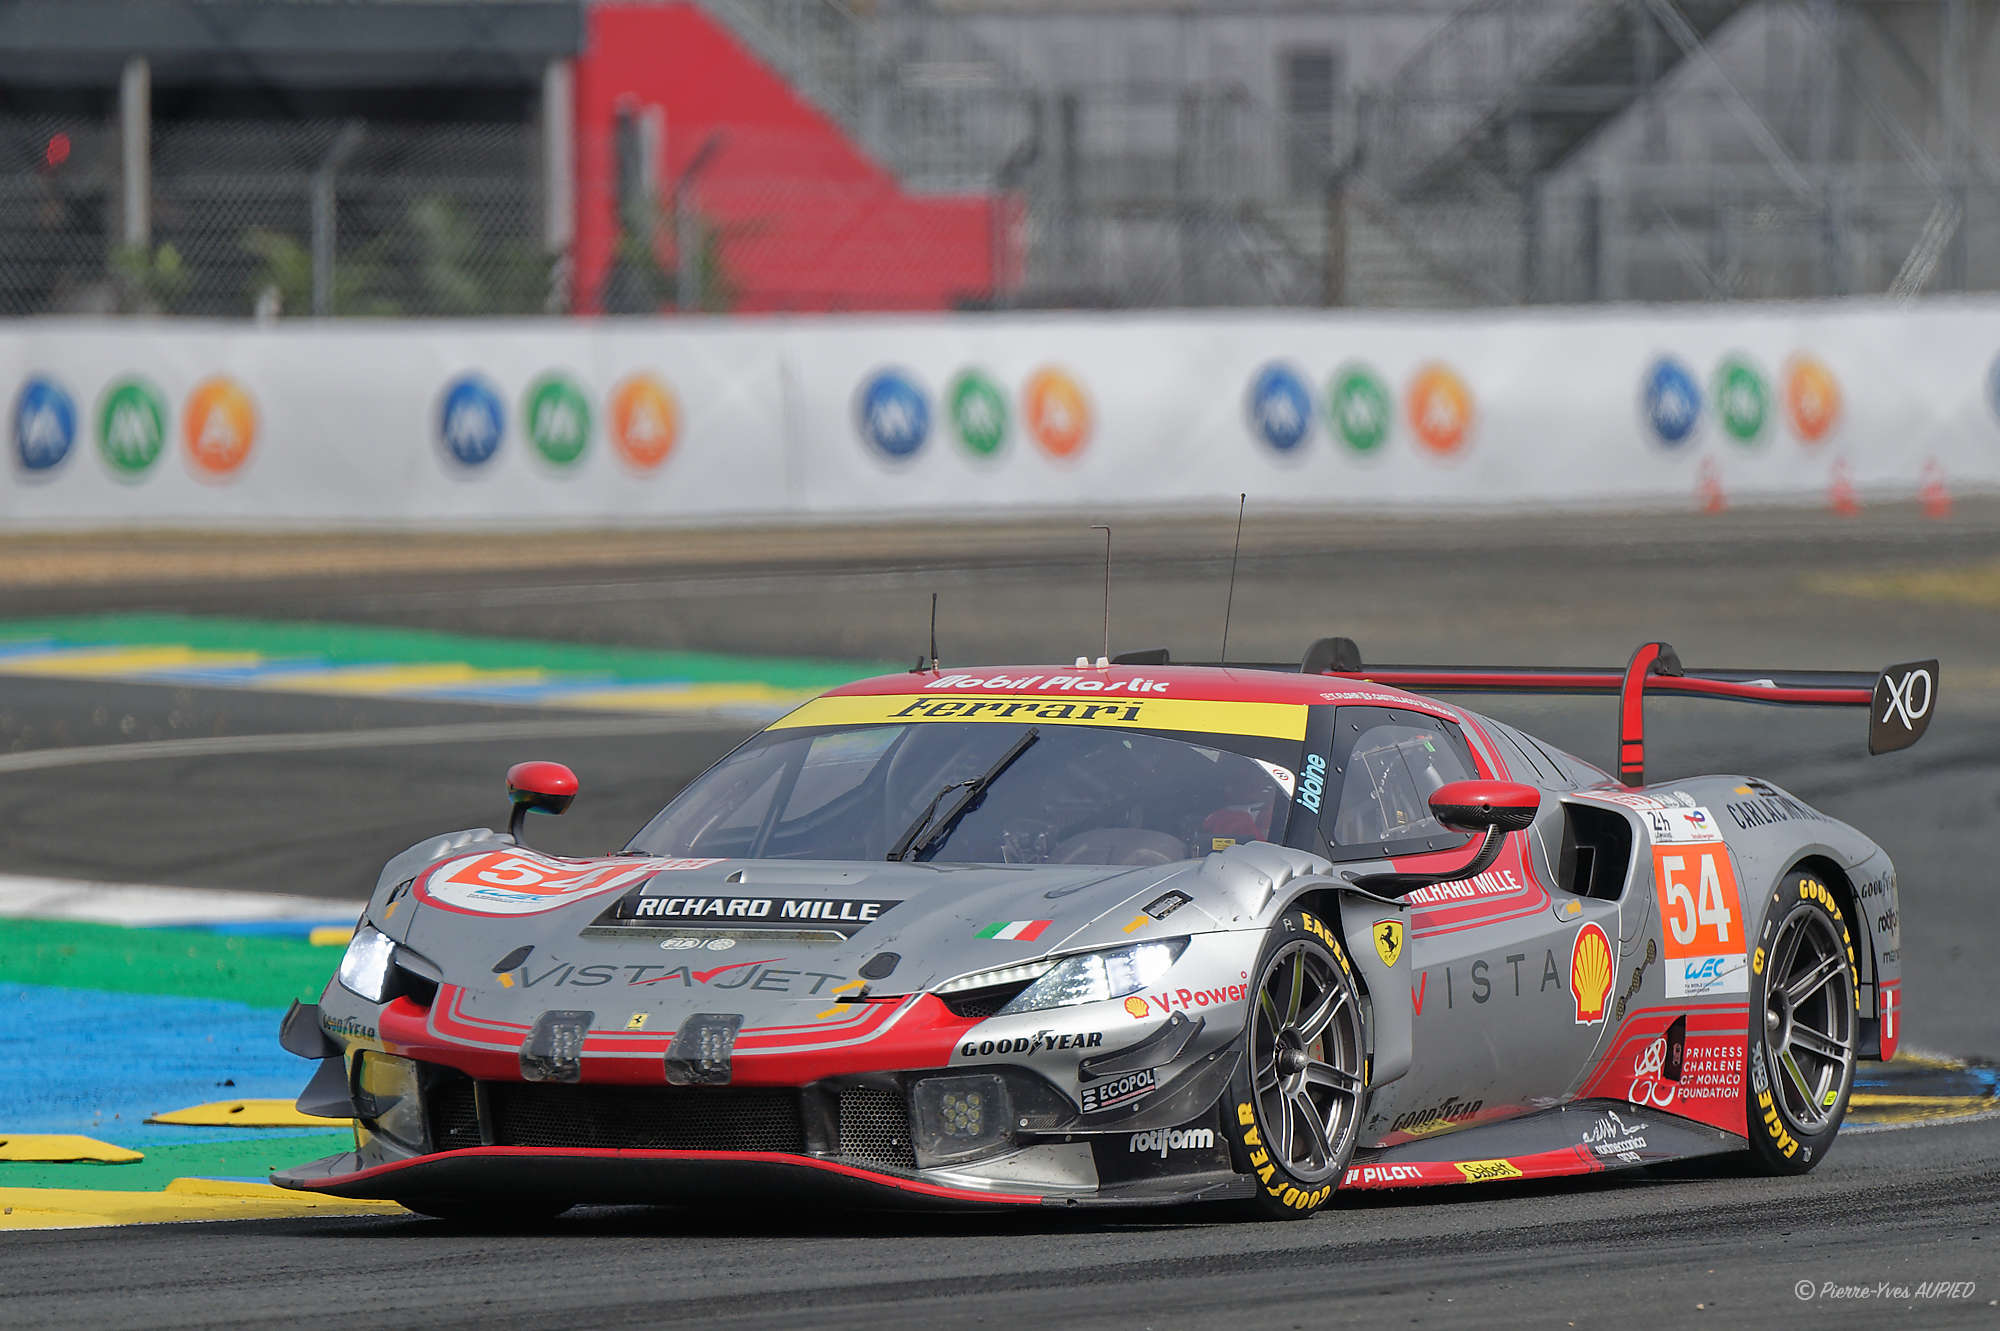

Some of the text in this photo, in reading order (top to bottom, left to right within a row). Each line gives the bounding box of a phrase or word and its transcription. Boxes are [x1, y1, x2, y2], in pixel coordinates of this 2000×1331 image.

[924, 675, 1171, 693] Mobil Plastic
[887, 697, 1145, 722] Ferrari
[1881, 668, 1933, 731] XO
[1296, 753, 1327, 815] idoine
[1472, 870, 1522, 895] MILLE
[635, 898, 882, 922] RICHARD MILLE
[1662, 853, 1731, 945] 54
[1685, 958, 1725, 980] WEC
[1411, 948, 1561, 1018] VISTA
[1150, 982, 1249, 1014] V-Power
[961, 1030, 1103, 1057] GOODYEAR
[1685, 1046, 1743, 1059] PRINCESS
[1683, 1060, 1742, 1073] CHARLENE
[1100, 1067, 1155, 1101] ECOPOL
[1680, 1074, 1741, 1086] OF MONACO
[1677, 1087, 1740, 1099] FOUNDATION
[1391, 1096, 1483, 1132] GOODYEAR
[1129, 1126, 1215, 1158] rotiform
[1363, 1166, 1422, 1183] PILOTI
